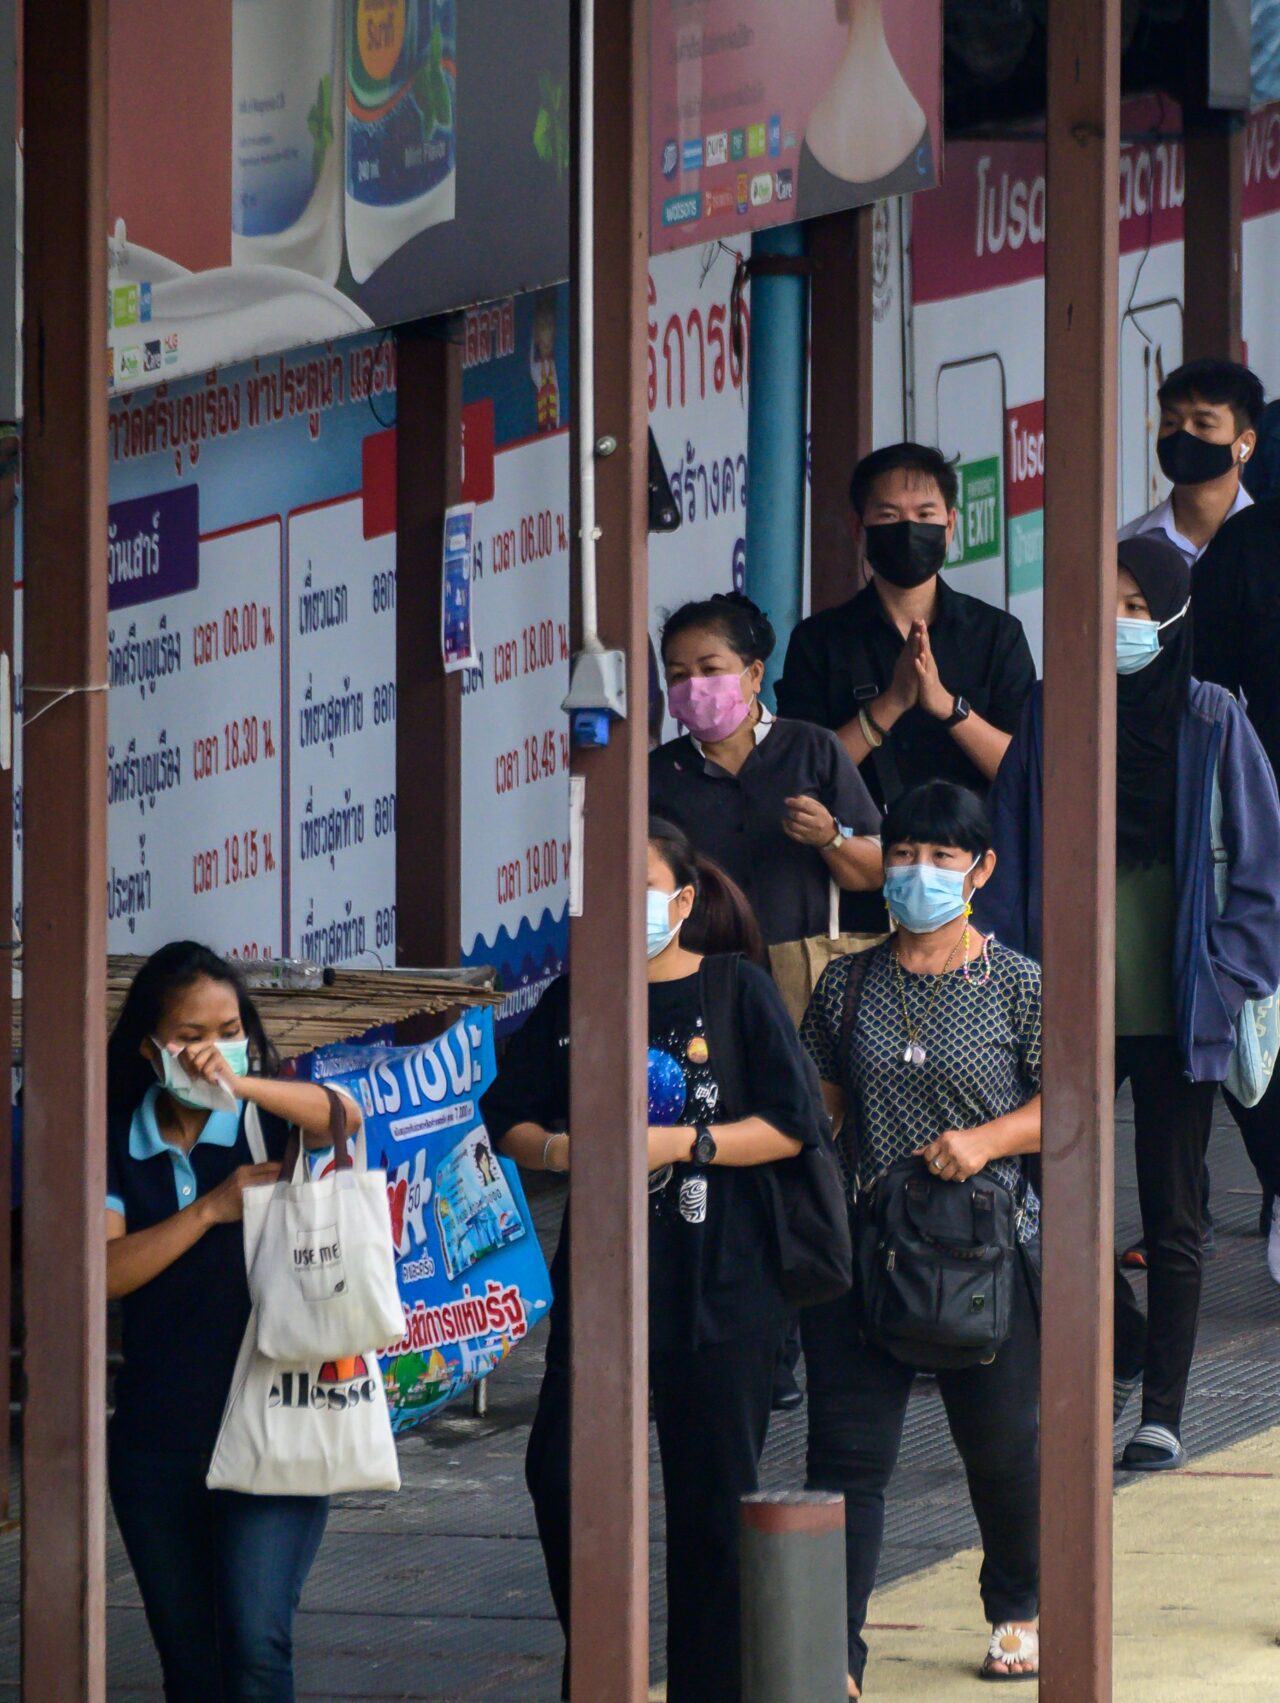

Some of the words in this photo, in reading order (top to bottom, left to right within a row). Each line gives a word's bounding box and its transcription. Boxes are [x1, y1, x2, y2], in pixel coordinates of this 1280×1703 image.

[968, 498, 995, 548] EXIT
[373, 570, 397, 614] ออก
[492, 529, 516, 574] เวลา
[521, 510, 552, 565] 06.00
[194, 621, 219, 667] เวลา
[223, 602, 257, 657] 06.00
[262, 606, 275, 646] น.
[493, 640, 517, 684] เวลา
[522, 620, 554, 674] 18.00
[193, 735, 219, 780] เวลา
[224, 715, 258, 771] 18.30
[263, 720, 275, 759] น.
[495, 747, 520, 795] เวลา
[524, 730, 556, 785] 18.45
[193, 849, 219, 895] เวลา
[224, 829, 258, 885] 19.15
[263, 832, 276, 872] น.
[497, 859, 521, 905] เวลา
[526, 838, 558, 895] 19.00
[407, 1183, 421, 1213] 50
[293, 1248, 316, 1265] USE
[319, 1243, 341, 1264] ME
[268, 1371, 376, 1411] ellesse
